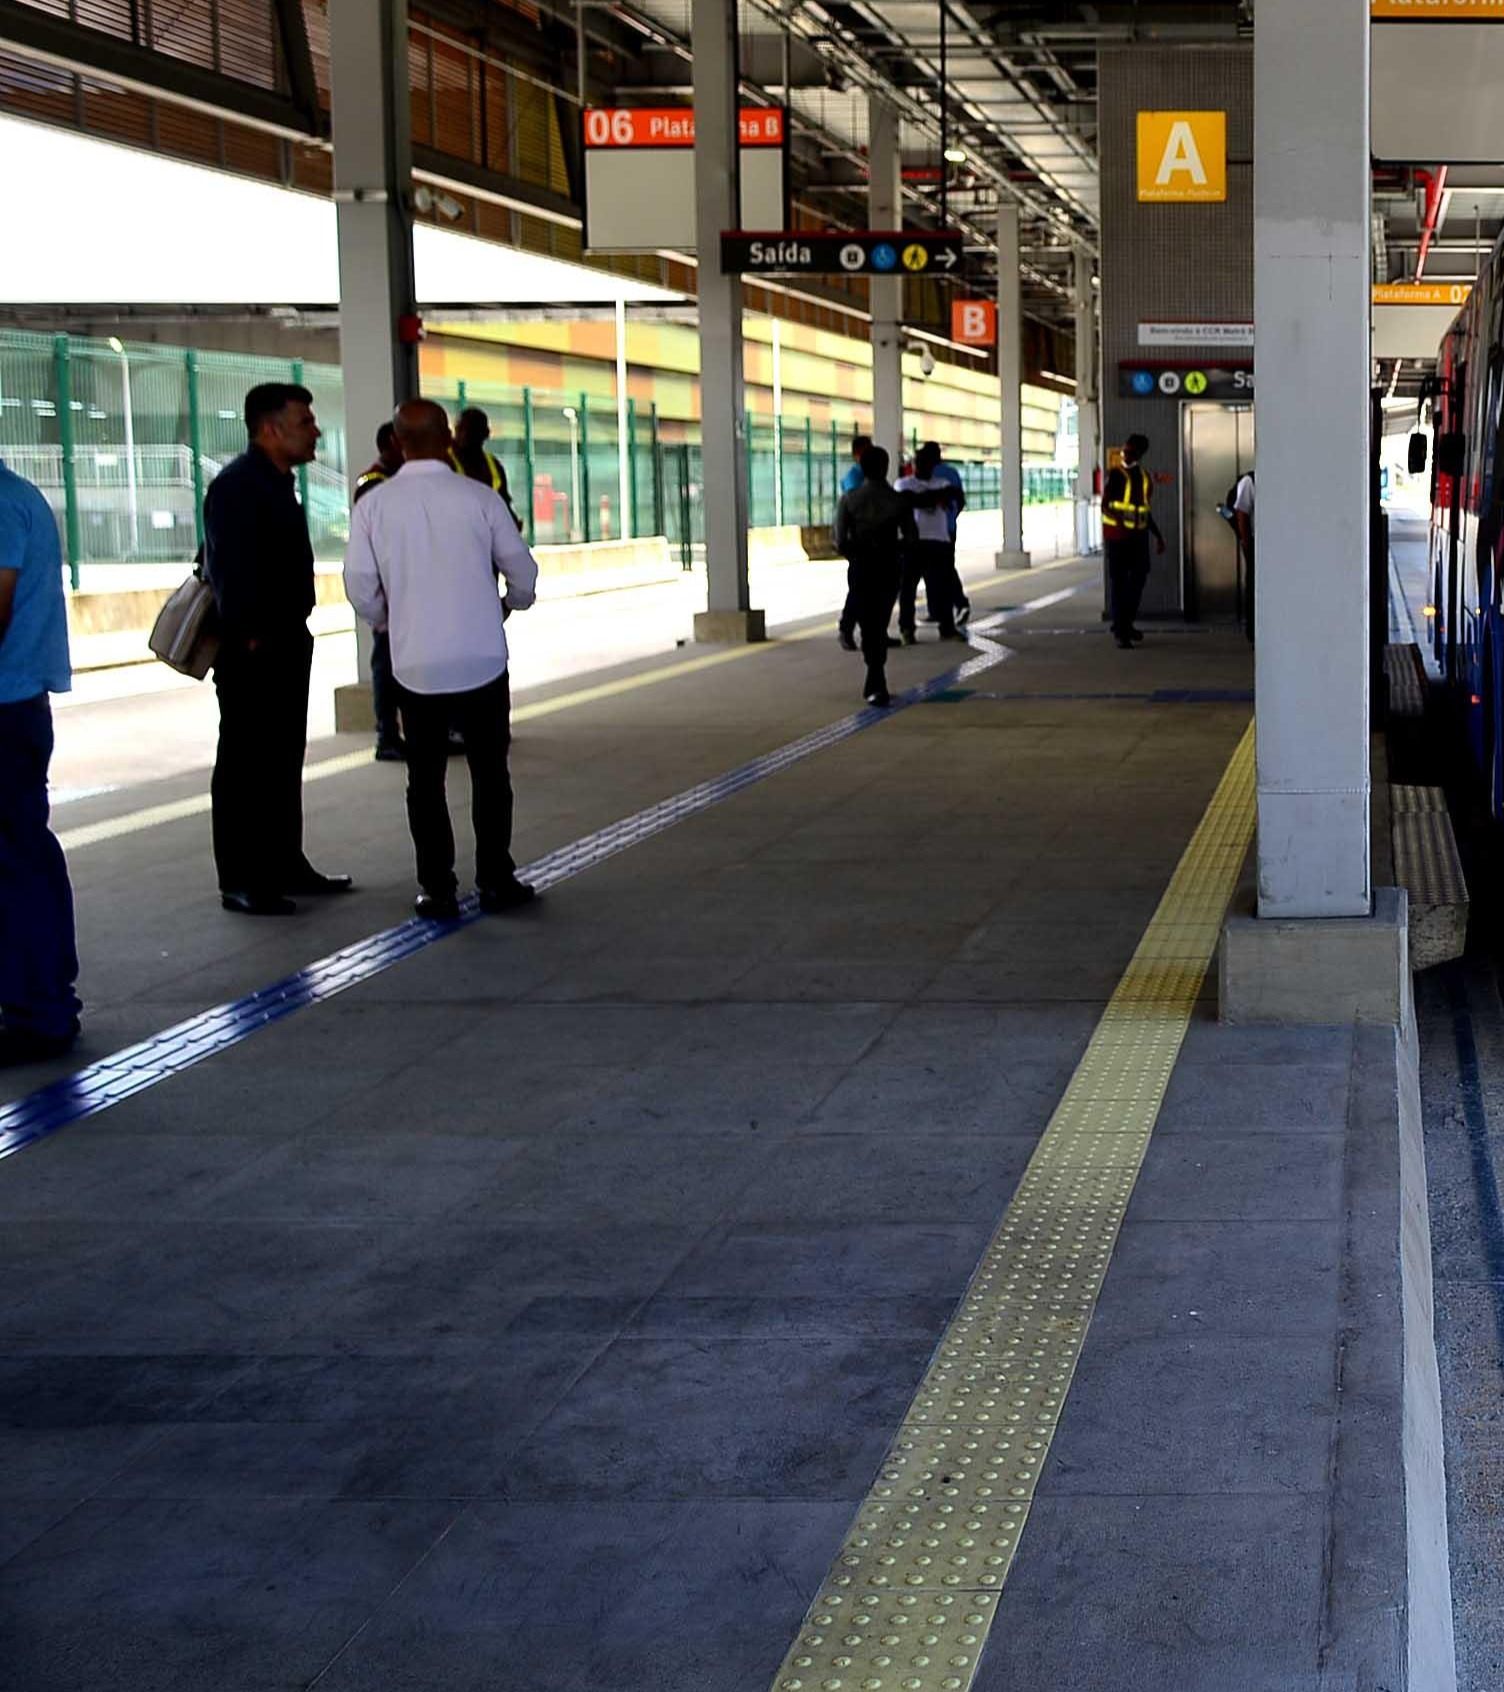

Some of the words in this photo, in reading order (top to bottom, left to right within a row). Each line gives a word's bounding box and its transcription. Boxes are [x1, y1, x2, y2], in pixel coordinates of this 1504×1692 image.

[587, 110, 634, 145] 06
[766, 117, 779, 136] B
[1155, 121, 1208, 185] A
[750, 242, 812, 264] Saída
[963, 305, 987, 338] B
